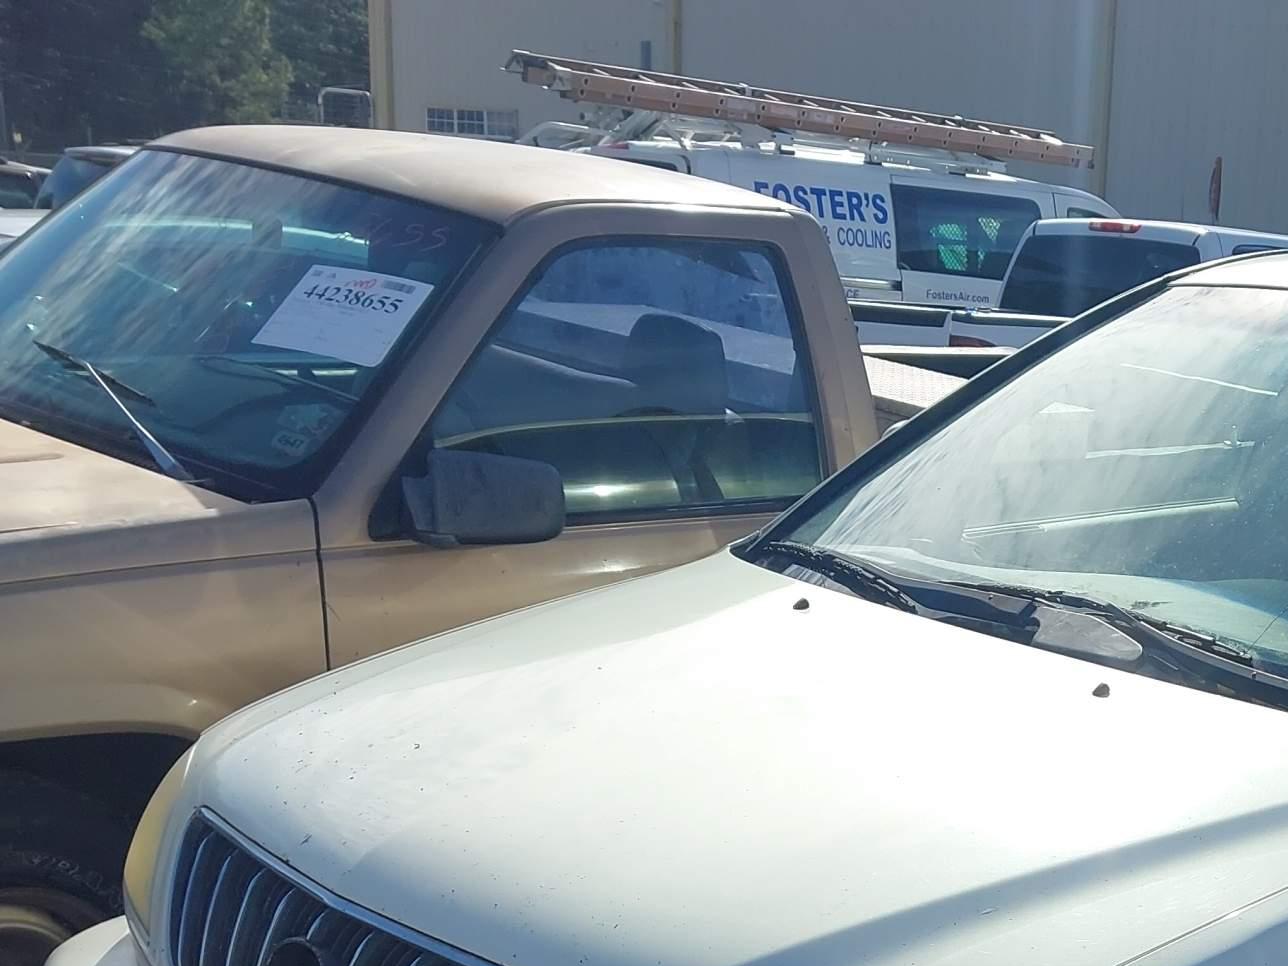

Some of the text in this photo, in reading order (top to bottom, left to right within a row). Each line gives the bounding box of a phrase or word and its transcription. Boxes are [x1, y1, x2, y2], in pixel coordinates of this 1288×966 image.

[837, 227, 892, 249] COOLING
[303, 283, 404, 315] 44238655
[926, 289, 990, 304] FostersAir.com
